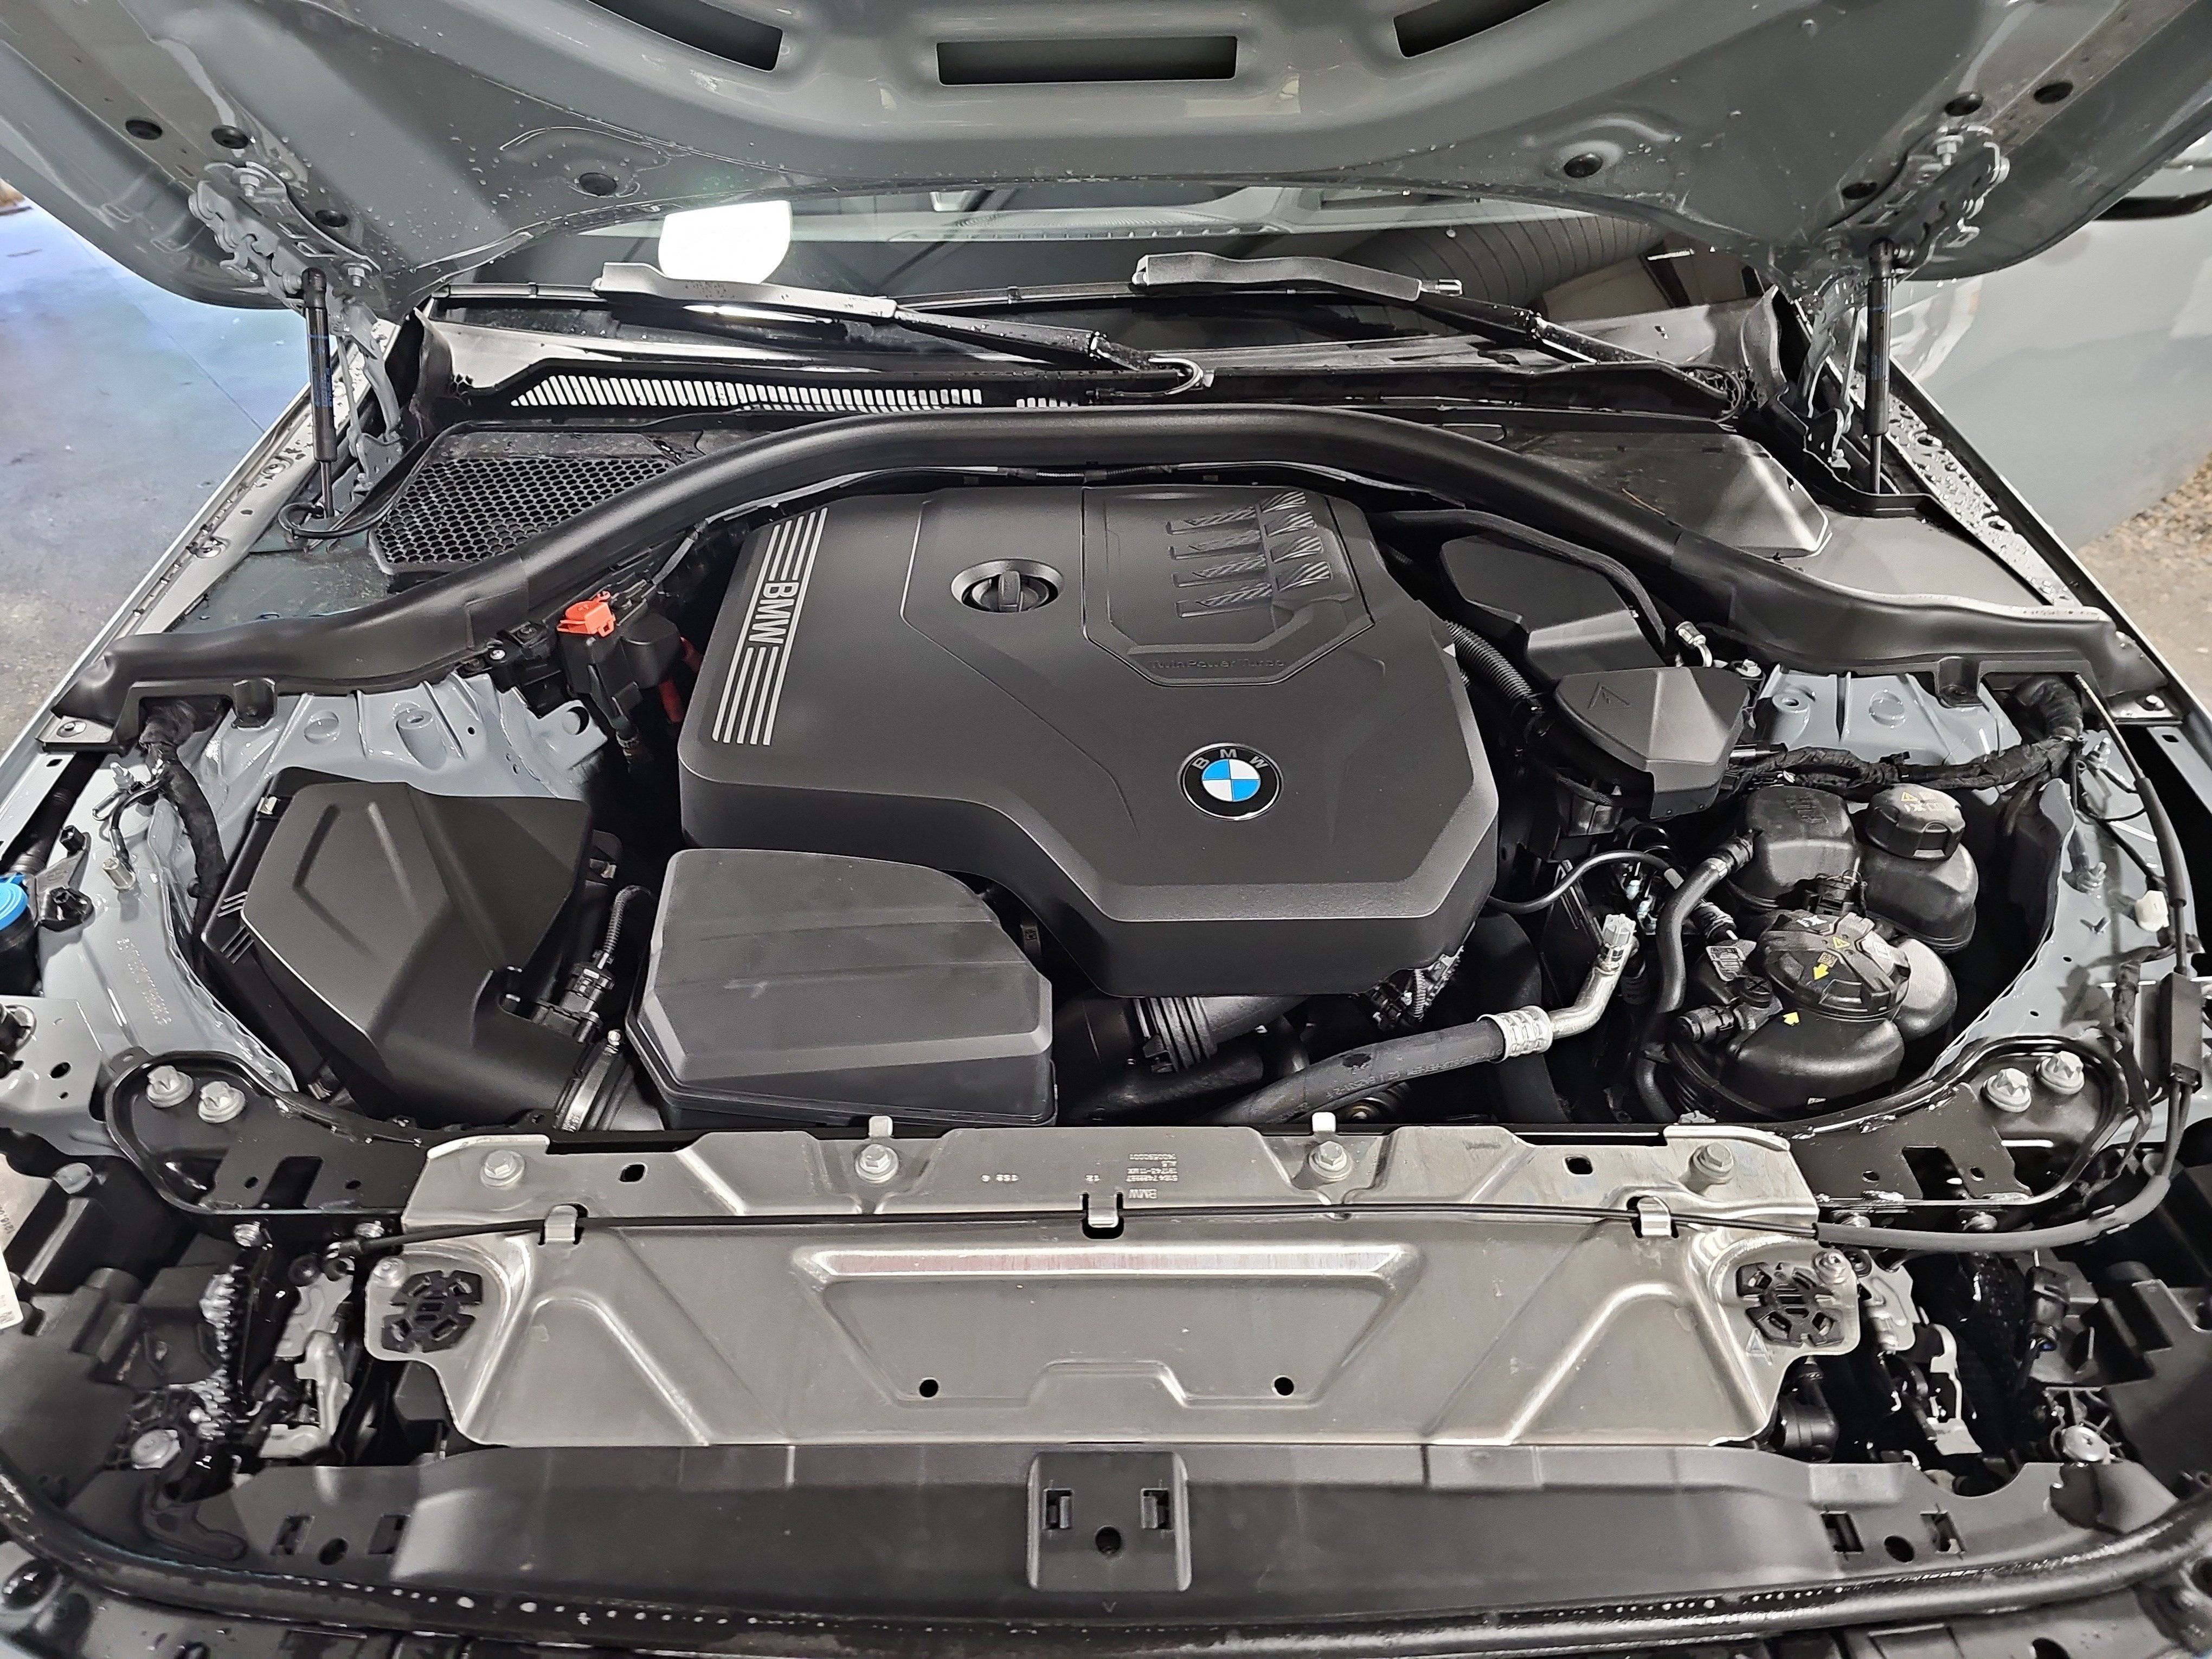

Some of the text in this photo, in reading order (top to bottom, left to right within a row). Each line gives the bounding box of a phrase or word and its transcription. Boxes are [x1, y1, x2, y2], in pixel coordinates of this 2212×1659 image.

[748, 582, 800, 644] BMW
[1191, 748, 1269, 770] BMW
[1128, 1189, 1158, 1199] BMW
